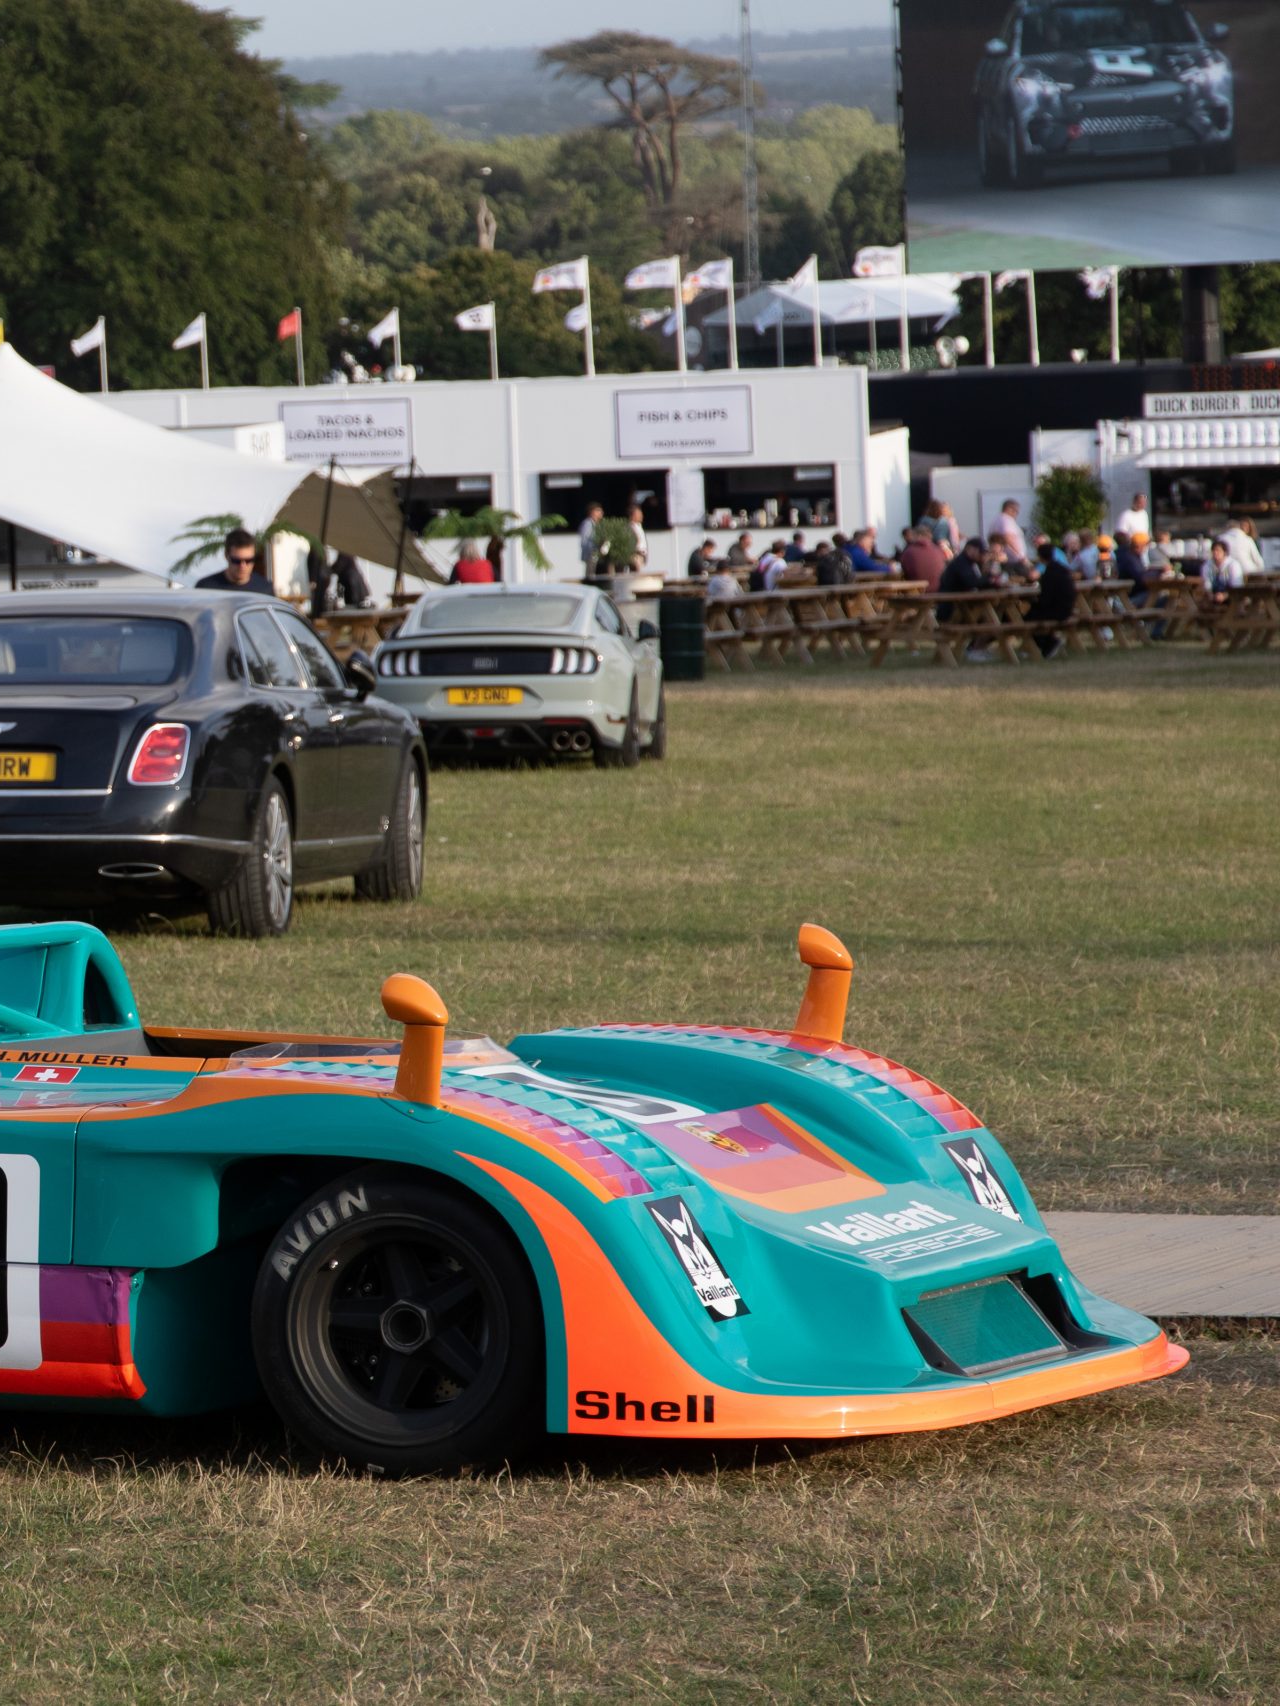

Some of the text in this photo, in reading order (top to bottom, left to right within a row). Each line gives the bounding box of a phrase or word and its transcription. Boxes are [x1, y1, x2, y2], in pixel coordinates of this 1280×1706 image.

[1153, 398, 1188, 413] DUCK
[1190, 396, 1241, 412] BURGER
[287, 426, 406, 441] LOADED NACHOS
[271, 1184, 369, 1283] AVON
[805, 1200, 958, 1246] Vaillant
[866, 1225, 997, 1263] PORSCHE
[696, 1283, 738, 1303] Vaillant
[575, 1390, 715, 1423] Shell
